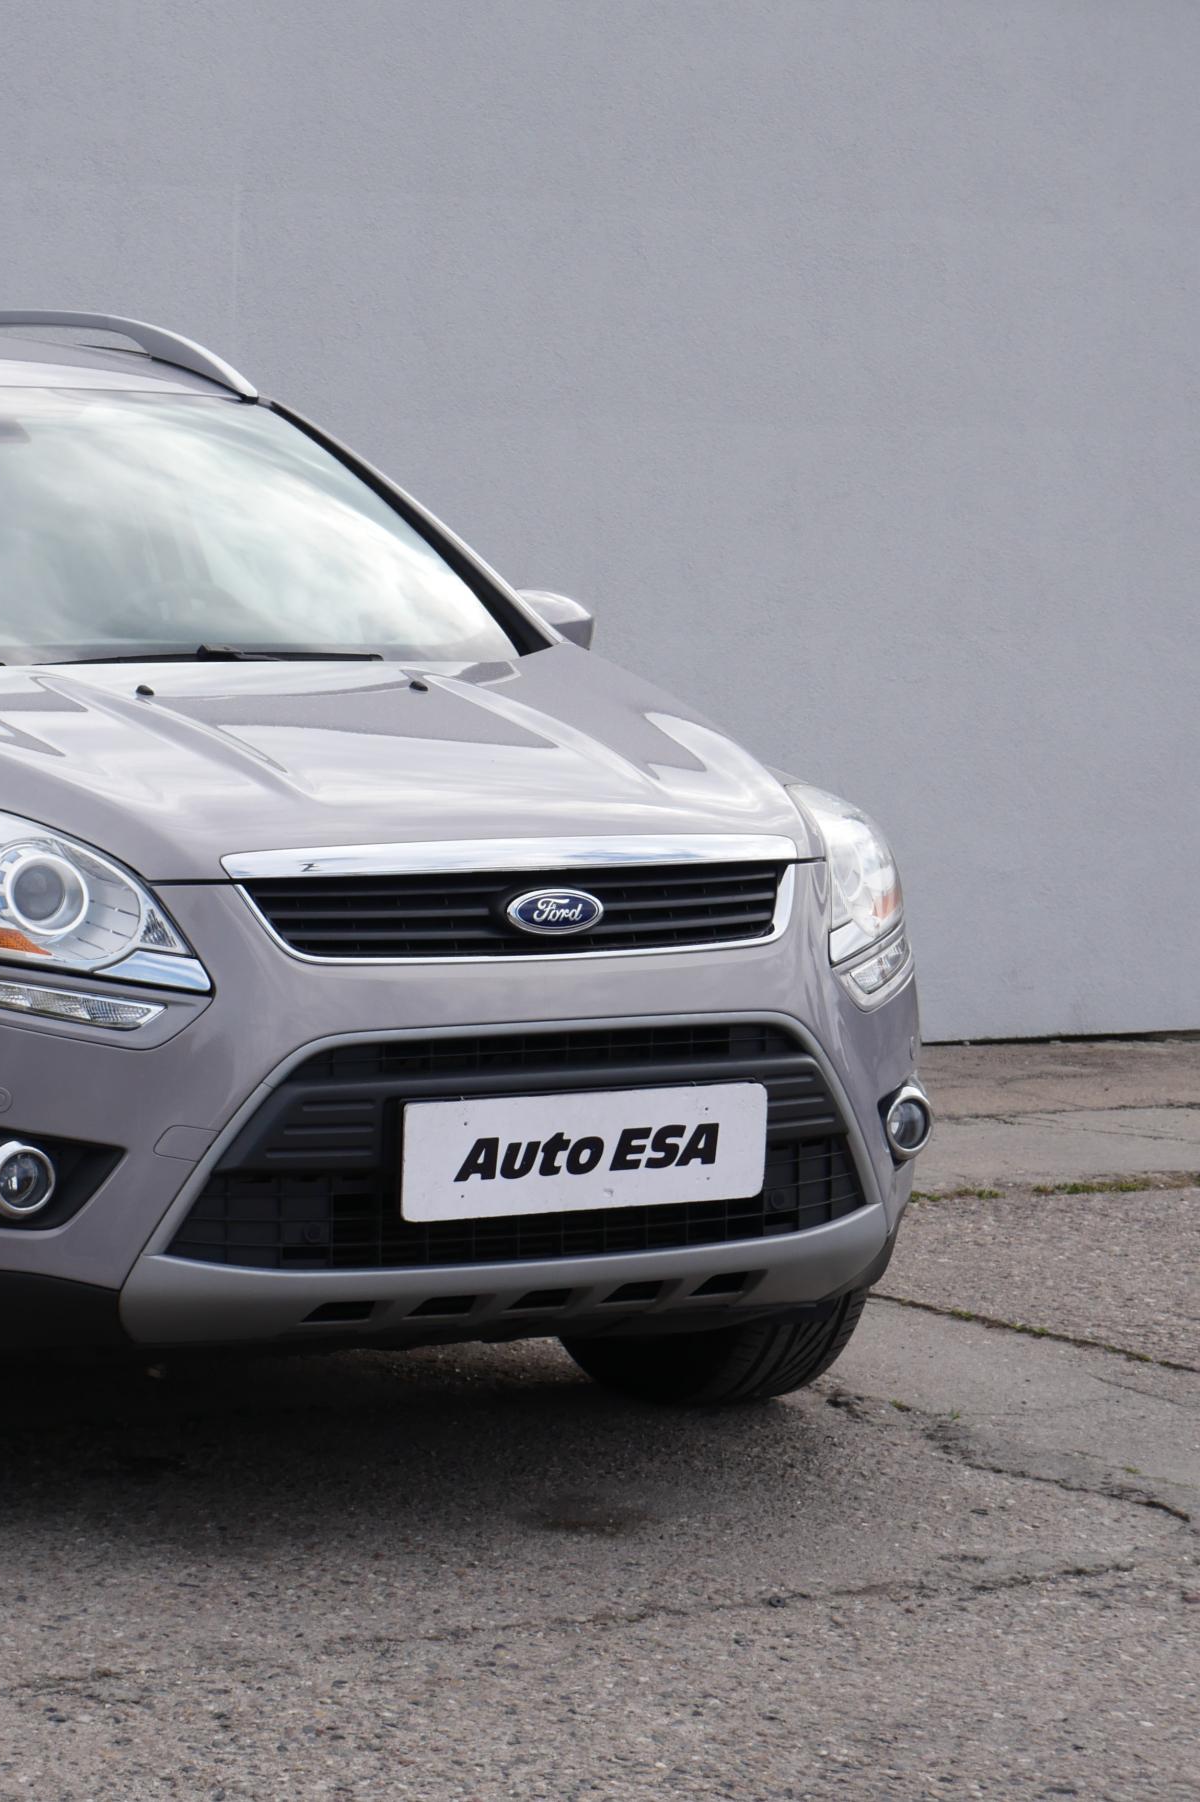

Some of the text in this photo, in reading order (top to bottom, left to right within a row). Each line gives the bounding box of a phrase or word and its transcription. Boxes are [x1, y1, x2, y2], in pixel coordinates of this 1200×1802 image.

[533, 898, 583, 922] Ford
[454, 1123, 719, 1182] Auto ESA
